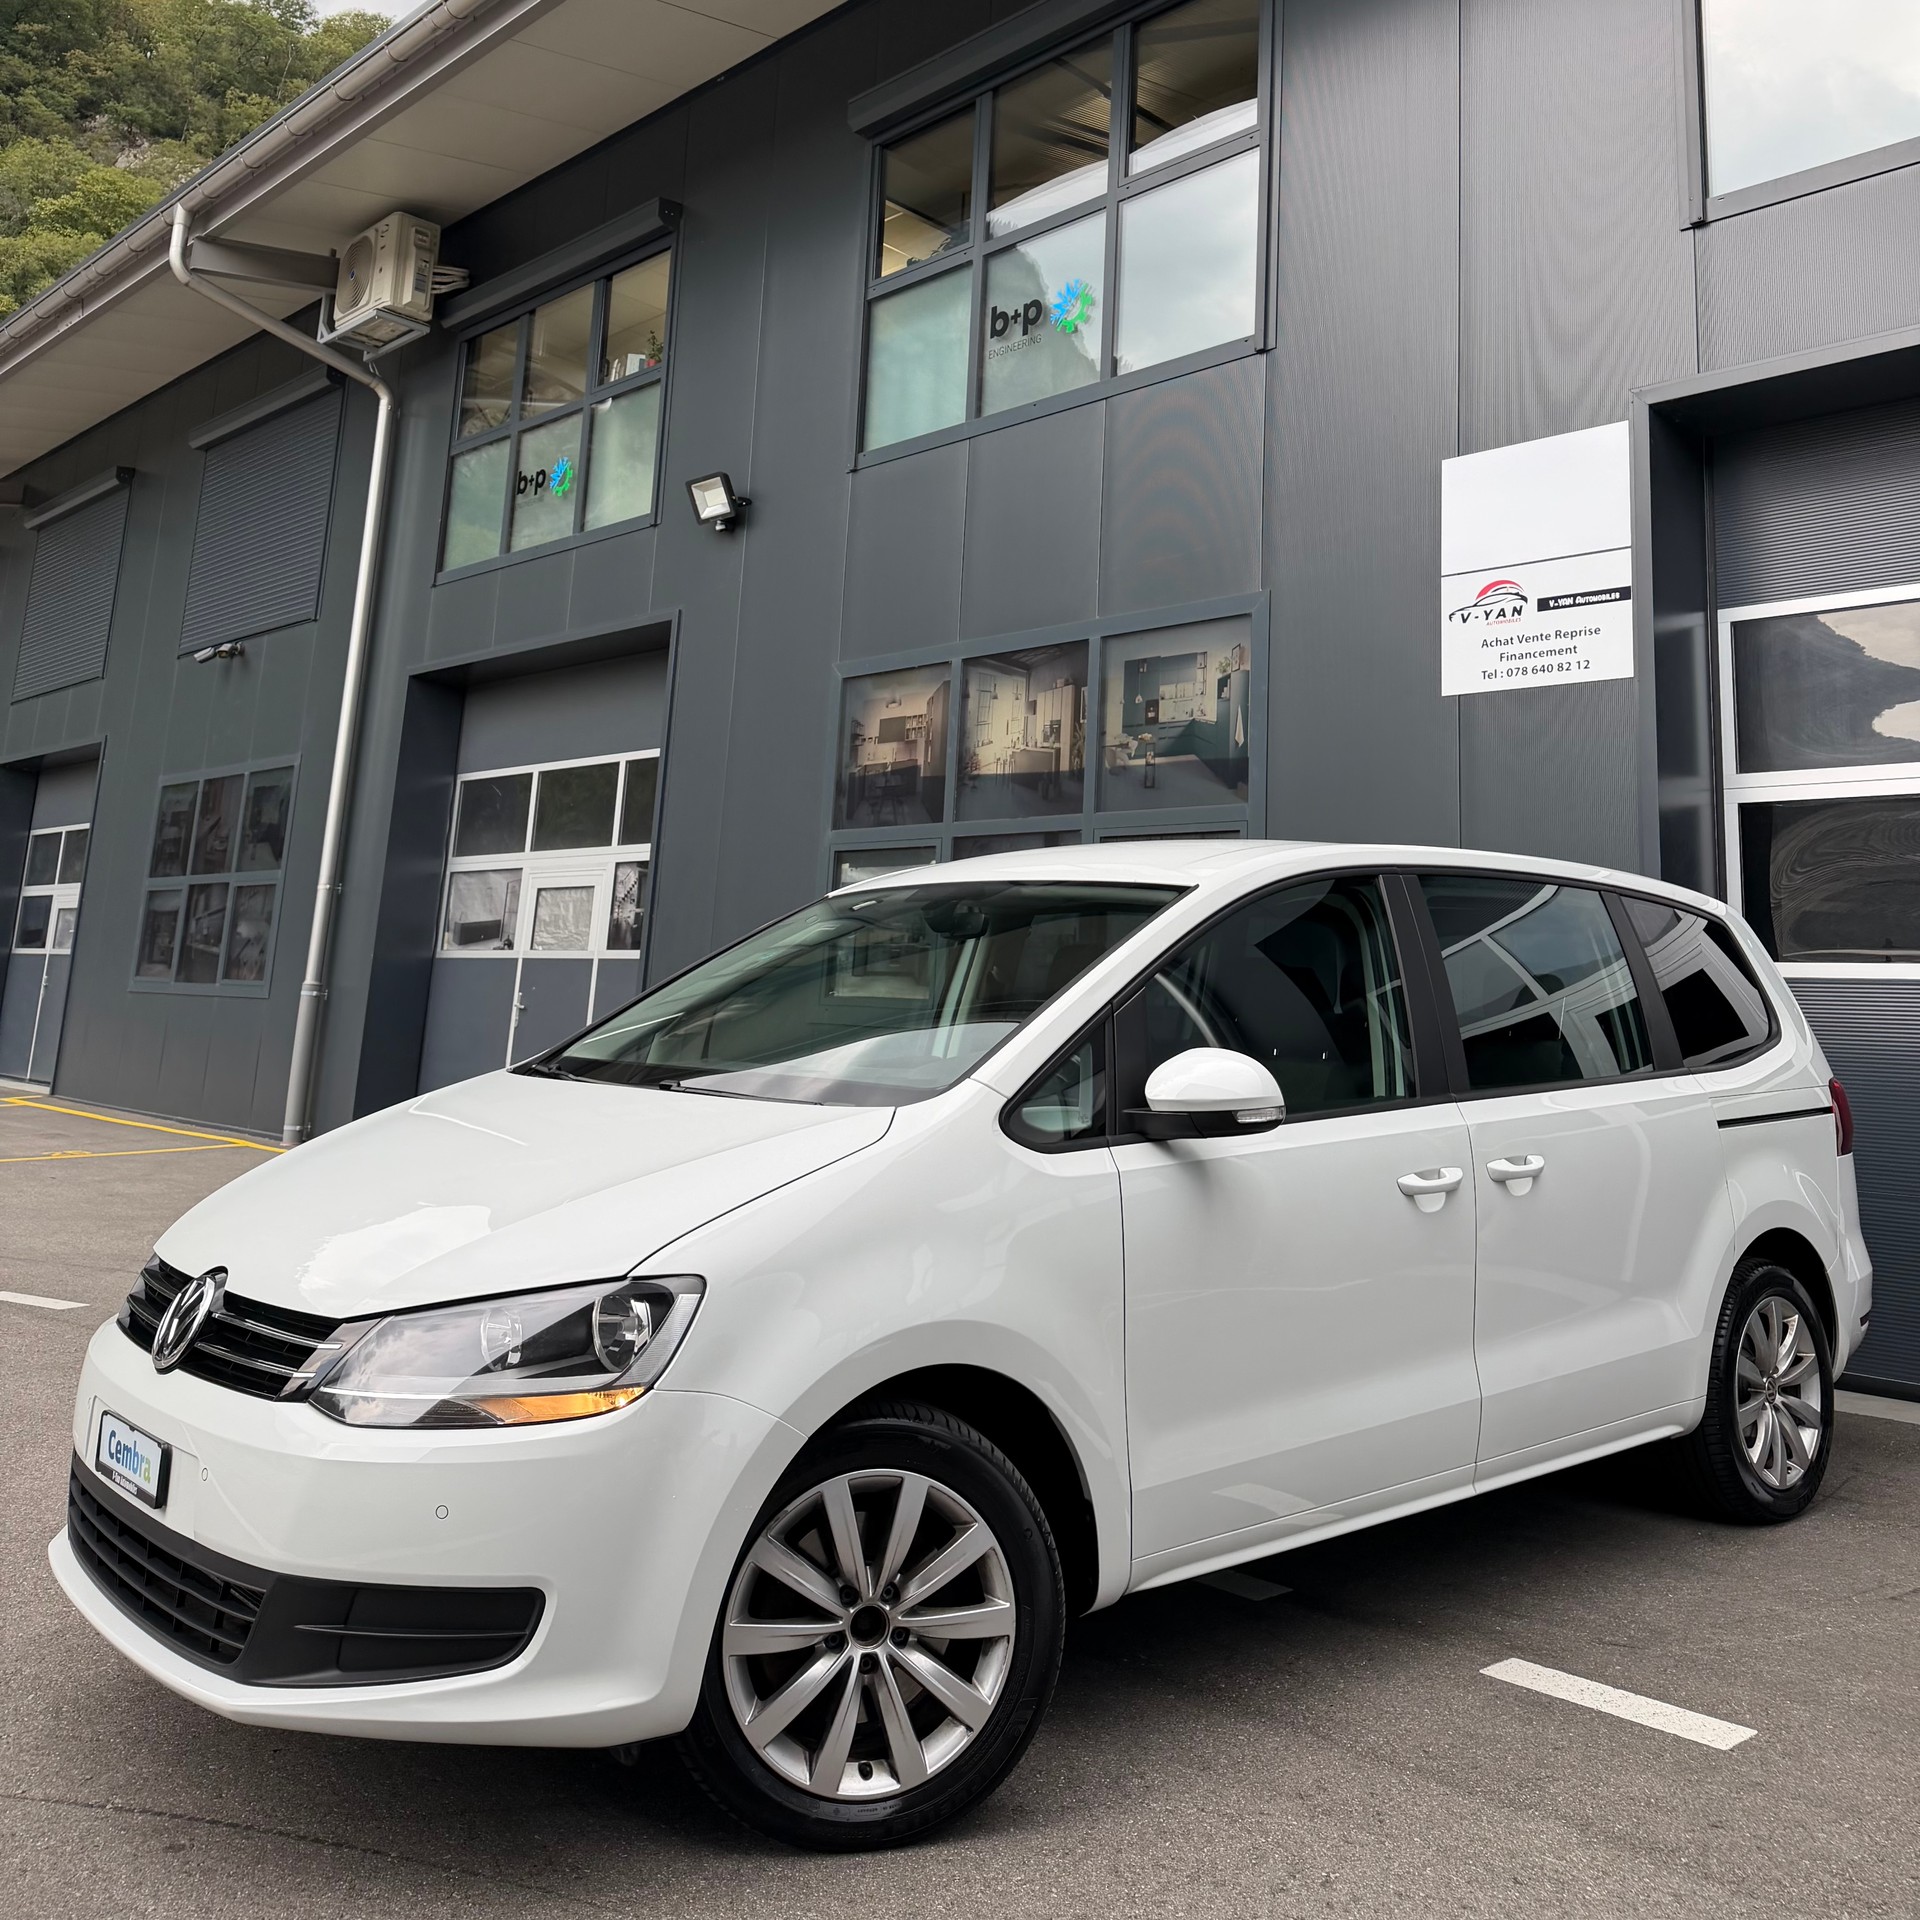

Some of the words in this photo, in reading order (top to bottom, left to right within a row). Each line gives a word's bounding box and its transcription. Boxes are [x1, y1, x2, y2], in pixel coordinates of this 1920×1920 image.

[990, 299, 1043, 339] b+p
[988, 334, 1042, 360] ENGINEERING
[516, 469, 546, 496] b+p
[1549, 597, 1574, 608] V-YAN
[1460, 605, 1523, 624] V-YAN
[1481, 636, 1514, 649] Achat
[1517, 631, 1551, 645] Vente
[1555, 626, 1601, 641] Reprise
[1499, 645, 1578, 662] Financement
[1506, 664, 1529, 678] 078
[1531, 662, 1554, 675] 640
[1557, 661, 1572, 672] 82
[1575, 659, 1591, 670] 12
[108, 1430, 151, 1484] Cembra
